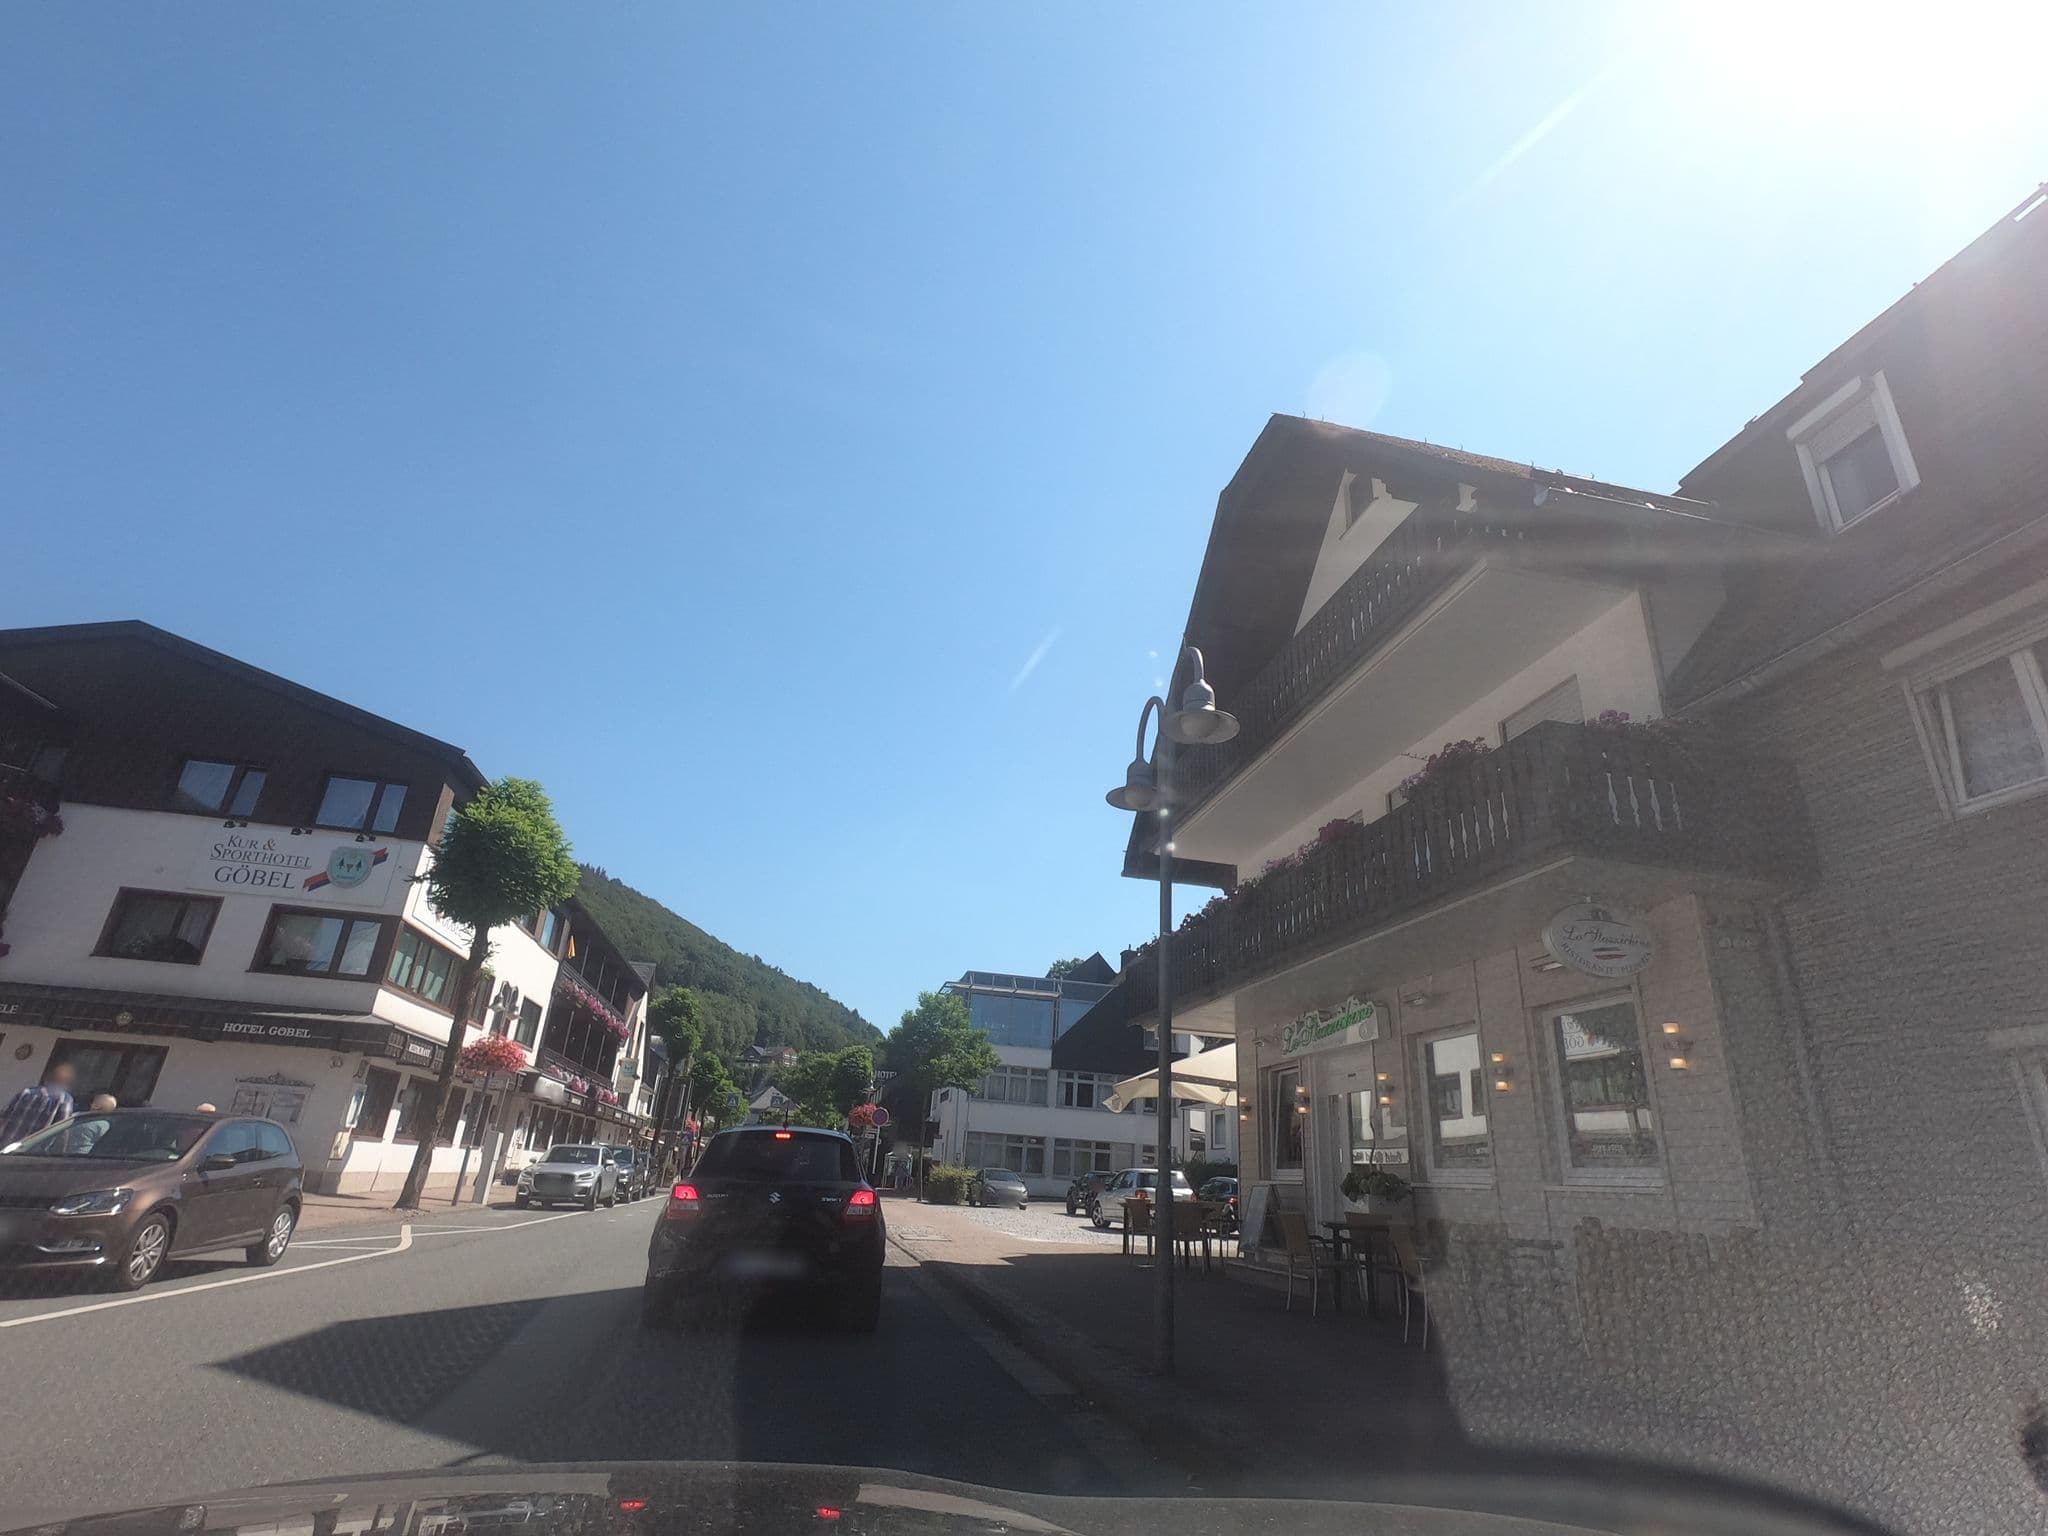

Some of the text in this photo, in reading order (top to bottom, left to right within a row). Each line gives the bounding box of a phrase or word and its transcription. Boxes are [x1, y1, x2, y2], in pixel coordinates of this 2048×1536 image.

[228, 834, 277, 851] KUR &
[211, 843, 313, 869] SPORTHOTEL
[214, 864, 296, 890] GÖBEL
[222, 1022, 265, 1035] HOTEL
